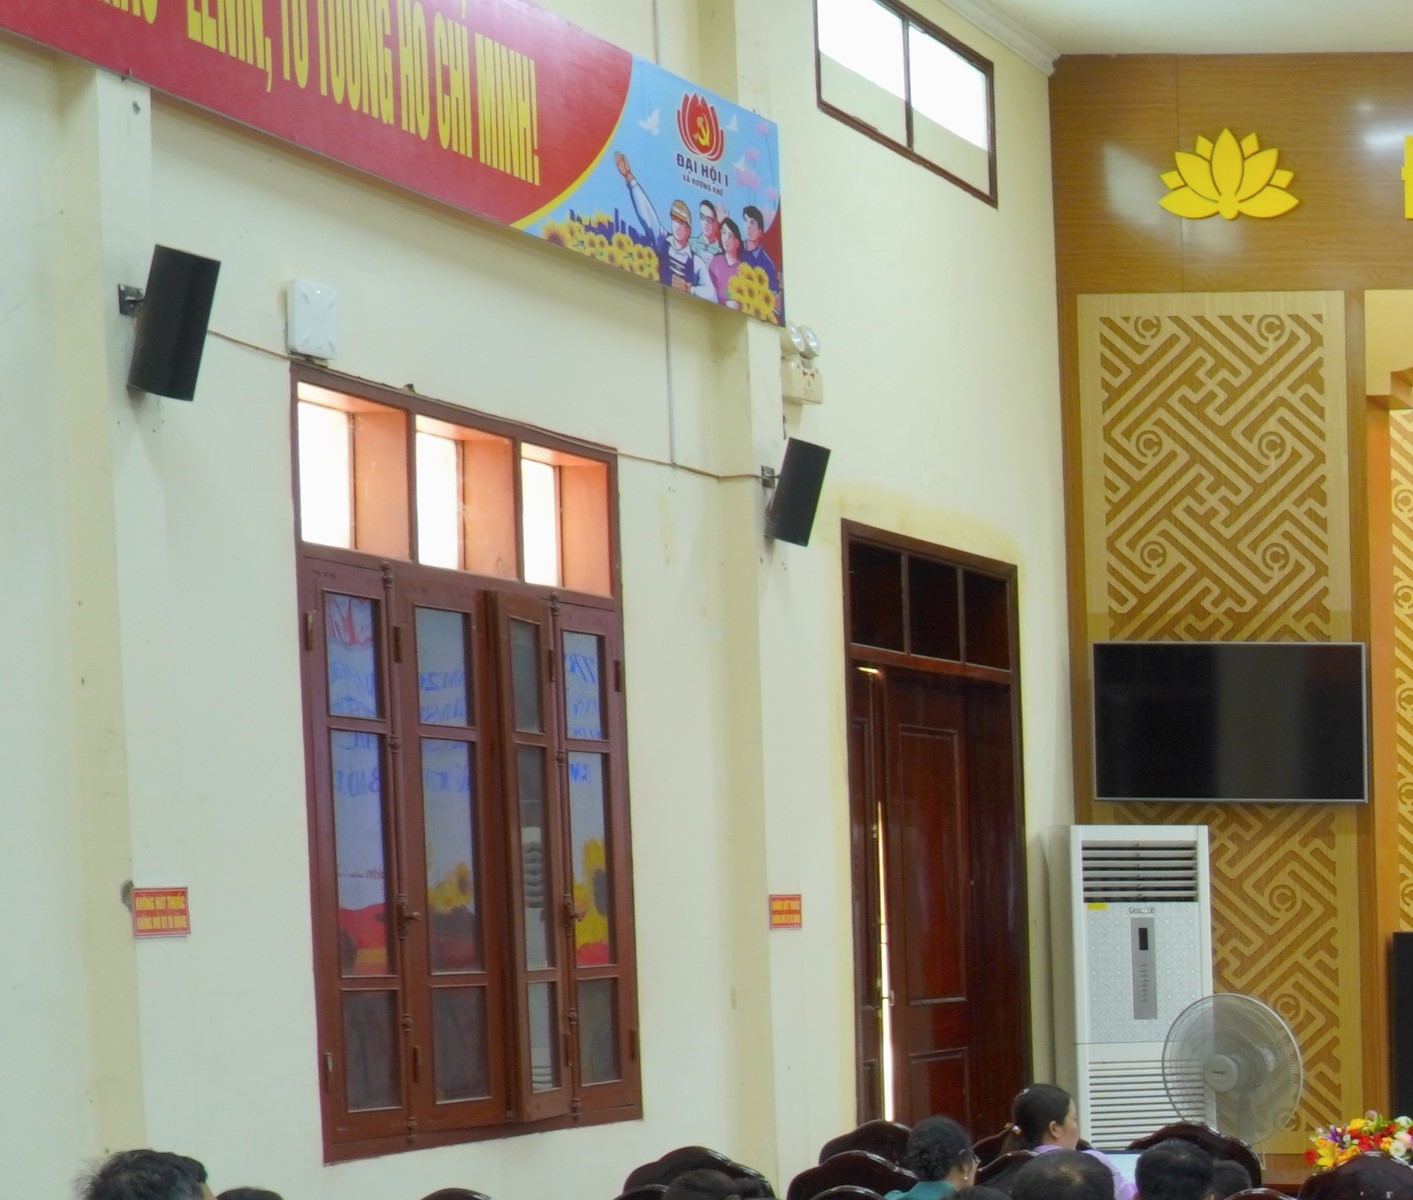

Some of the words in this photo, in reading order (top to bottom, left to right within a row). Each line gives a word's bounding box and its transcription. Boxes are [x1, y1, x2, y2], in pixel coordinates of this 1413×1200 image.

[475, 32, 540, 186] MINH!
[676, 153, 698, 175] ĐẠI
[701, 162, 722, 185] HỘI
